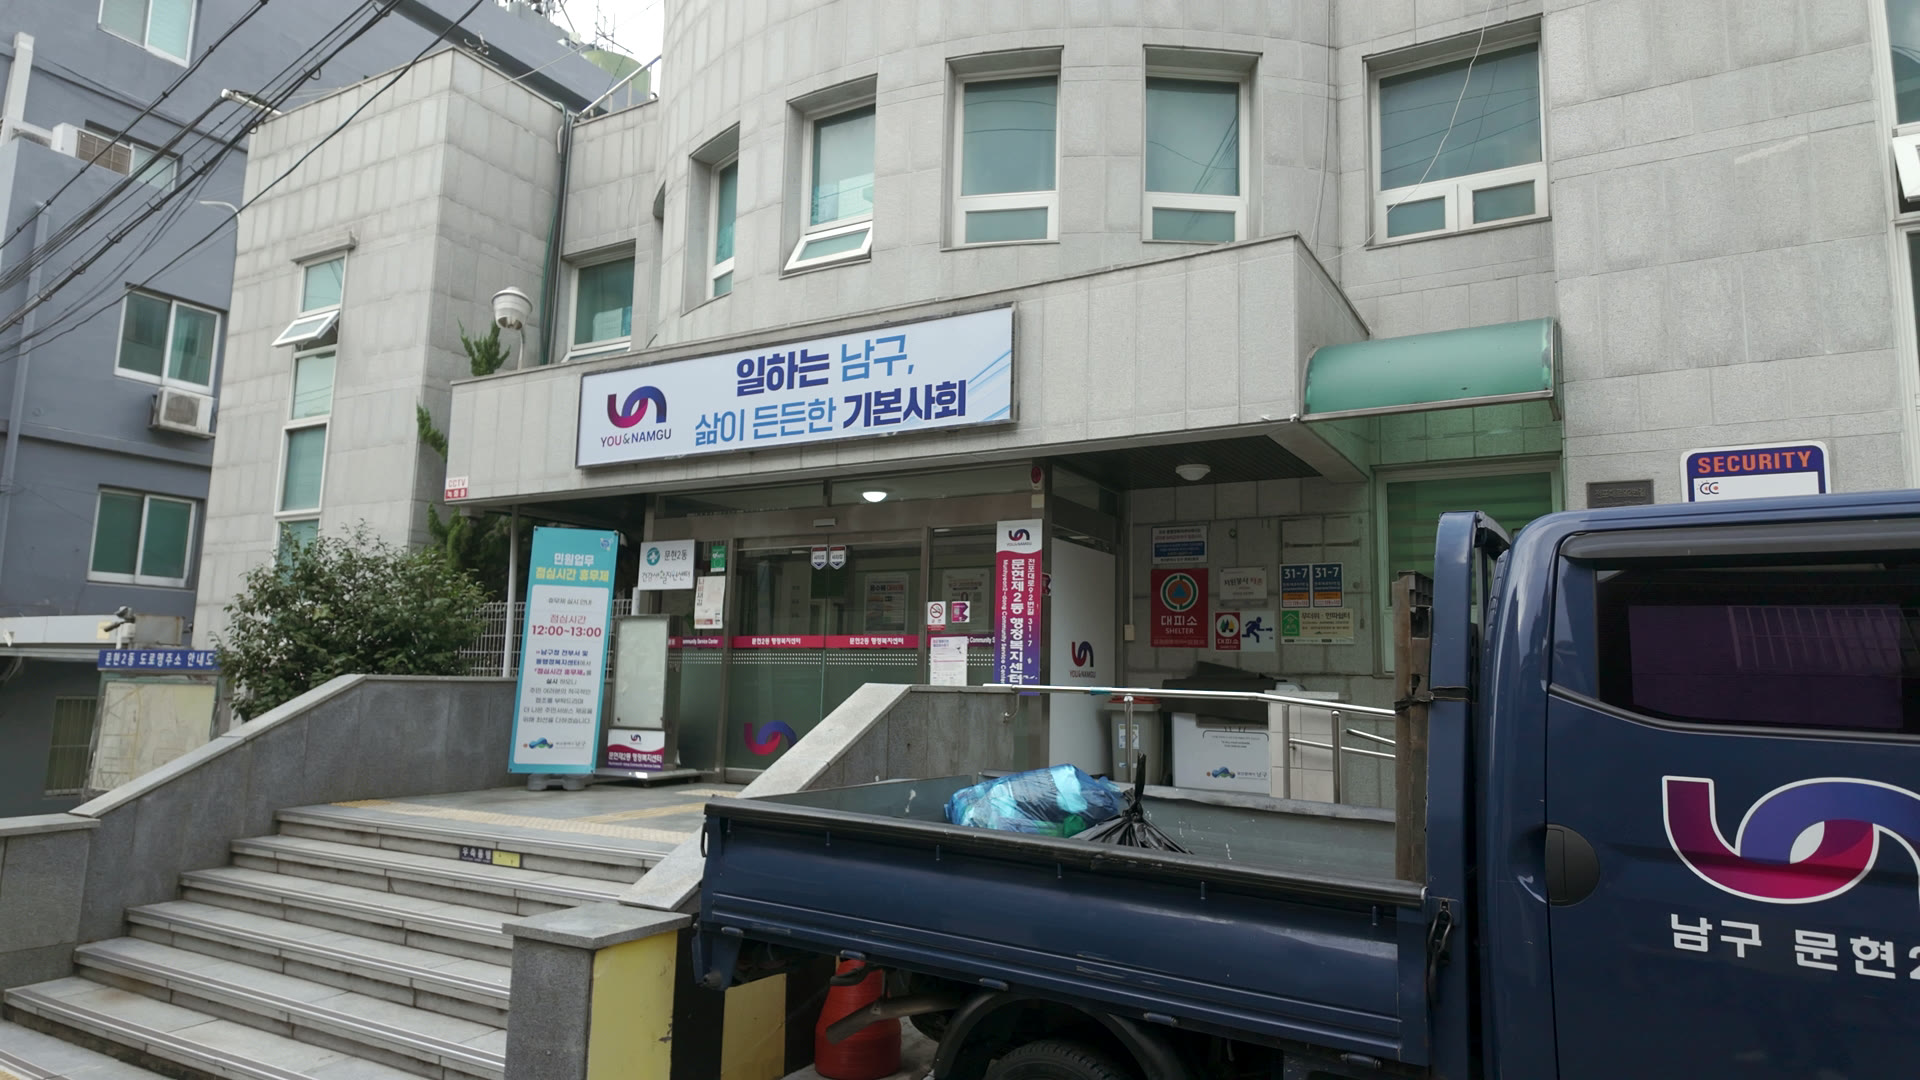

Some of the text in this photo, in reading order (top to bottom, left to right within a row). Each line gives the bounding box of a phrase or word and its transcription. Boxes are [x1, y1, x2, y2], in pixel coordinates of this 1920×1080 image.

[736, 334, 914, 397] 일하는 남구,
[695, 379, 967, 447] 삶이 든든한 기본사회
[600, 428, 672, 448] YOU&NAMGU
[1697, 450, 1812, 474] SECURITY
[448, 478, 466, 488] CCTV
[554, 552, 594, 567] 민원업무
[664, 549, 688, 562] 문현2동
[536, 566, 610, 582] 점심시간 휴무제
[1284, 568, 1308, 579] 31-7
[1314, 567, 1339, 578] 31-7
[550, 614, 587, 624] 점심시간
[1009, 558, 1024, 686] 문현제2동 행정복지센터
[1161, 616, 1198, 626] 대피소
[532, 625, 602, 638] 12:00~13:00
[849, 637, 904, 646] 문현2동 행정복지센터
[104, 652, 214, 666] 문현2동 도로명주소 안내도
[1670, 913, 1762, 958] 남구
